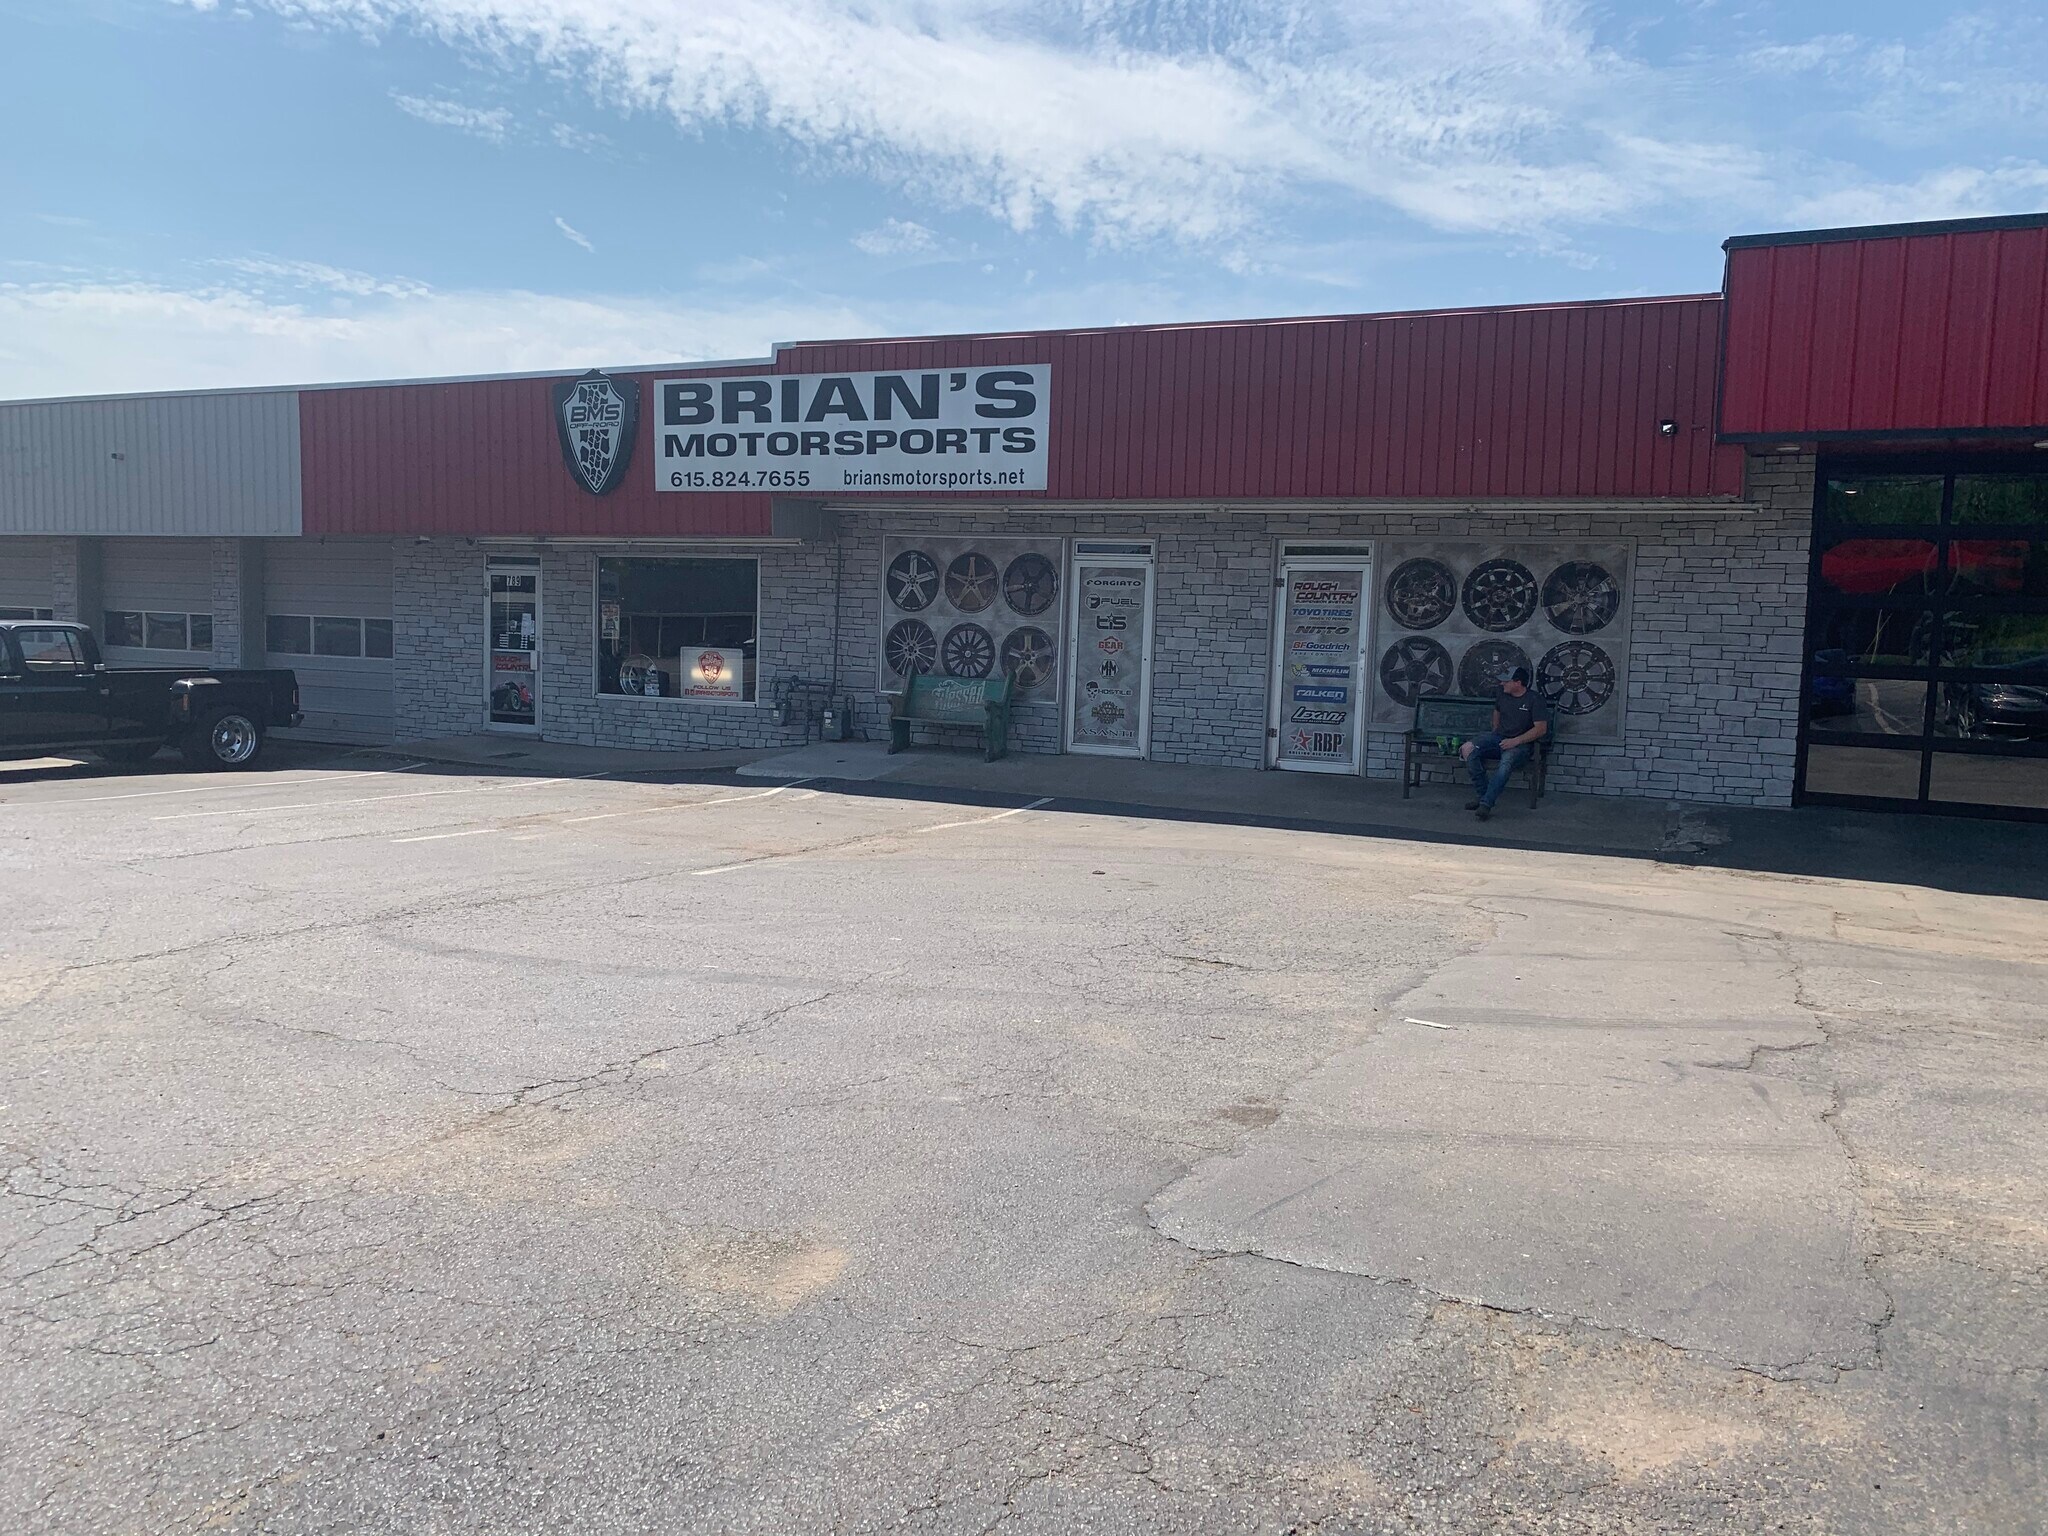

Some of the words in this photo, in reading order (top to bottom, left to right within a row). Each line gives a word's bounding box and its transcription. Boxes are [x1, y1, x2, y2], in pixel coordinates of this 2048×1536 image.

[664, 371, 1036, 425] BRIAN'S
[571, 404, 620, 422] BMS
[570, 421, 619, 429] OFF-ROAD
[664, 427, 1036, 457] MOTORSPORTS
[671, 471, 810, 487] 615.824.7655
[843, 468, 1025, 488] briansmotorsports.net
[507, 576, 521, 586] 789
[1086, 579, 1141, 587] FORGIATO
[1293, 582, 1338, 591] ROUGH
[1296, 592, 1358, 601] COUNTRY
[1101, 597, 1141, 606] FUEL
[1293, 608, 1321, 616] TOYO
[1322, 608, 1353, 617] TIRES
[1295, 625, 1350, 635] NITTO
[1098, 641, 1124, 649] GEAR
[1293, 641, 1350, 650] BFGoodrich
[1296, 689, 1344, 698] FALKEN
[1077, 728, 1134, 737] ASANTI
[1313, 732, 1342, 752] RBP
